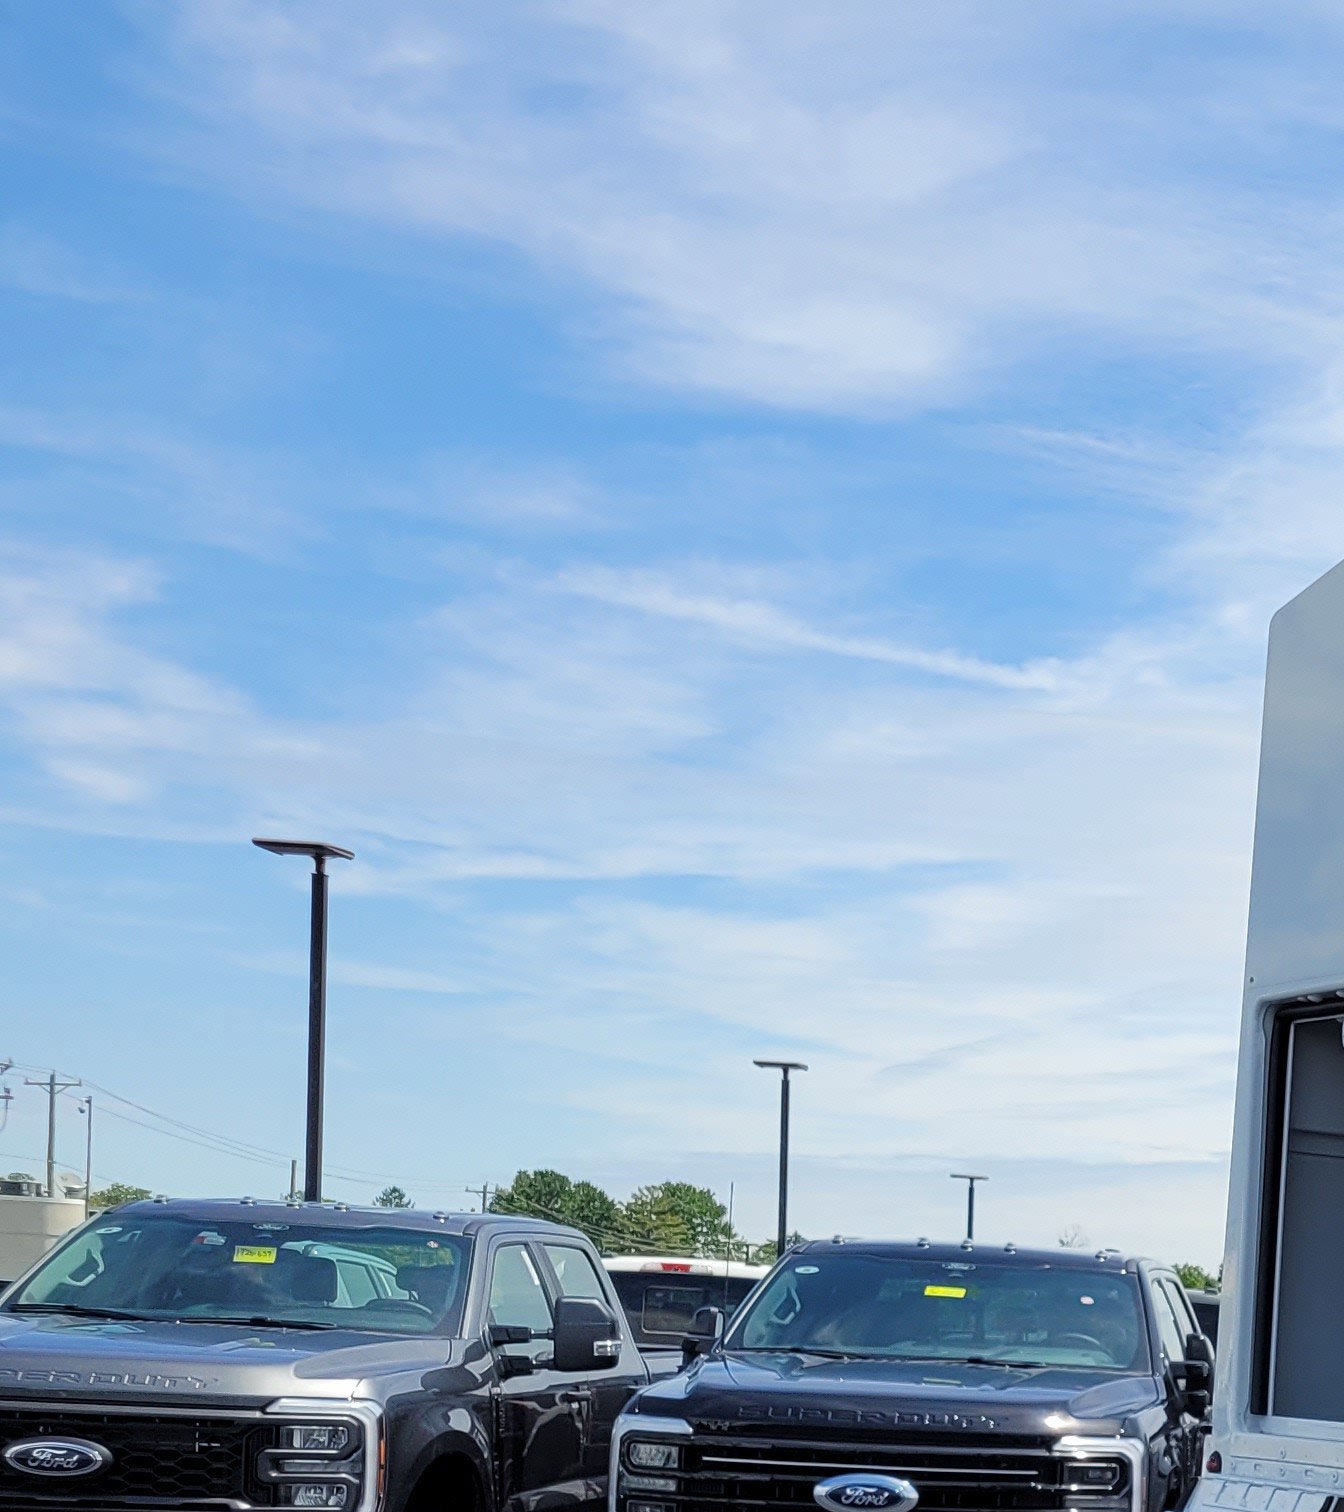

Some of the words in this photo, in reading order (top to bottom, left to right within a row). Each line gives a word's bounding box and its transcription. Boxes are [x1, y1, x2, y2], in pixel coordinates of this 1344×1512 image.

[88, 1372, 219, 1389] DUTY
[738, 1405, 888, 1424] SUPER
[27, 1447, 79, 1469] Ford
[840, 1486, 890, 1507] Ford
